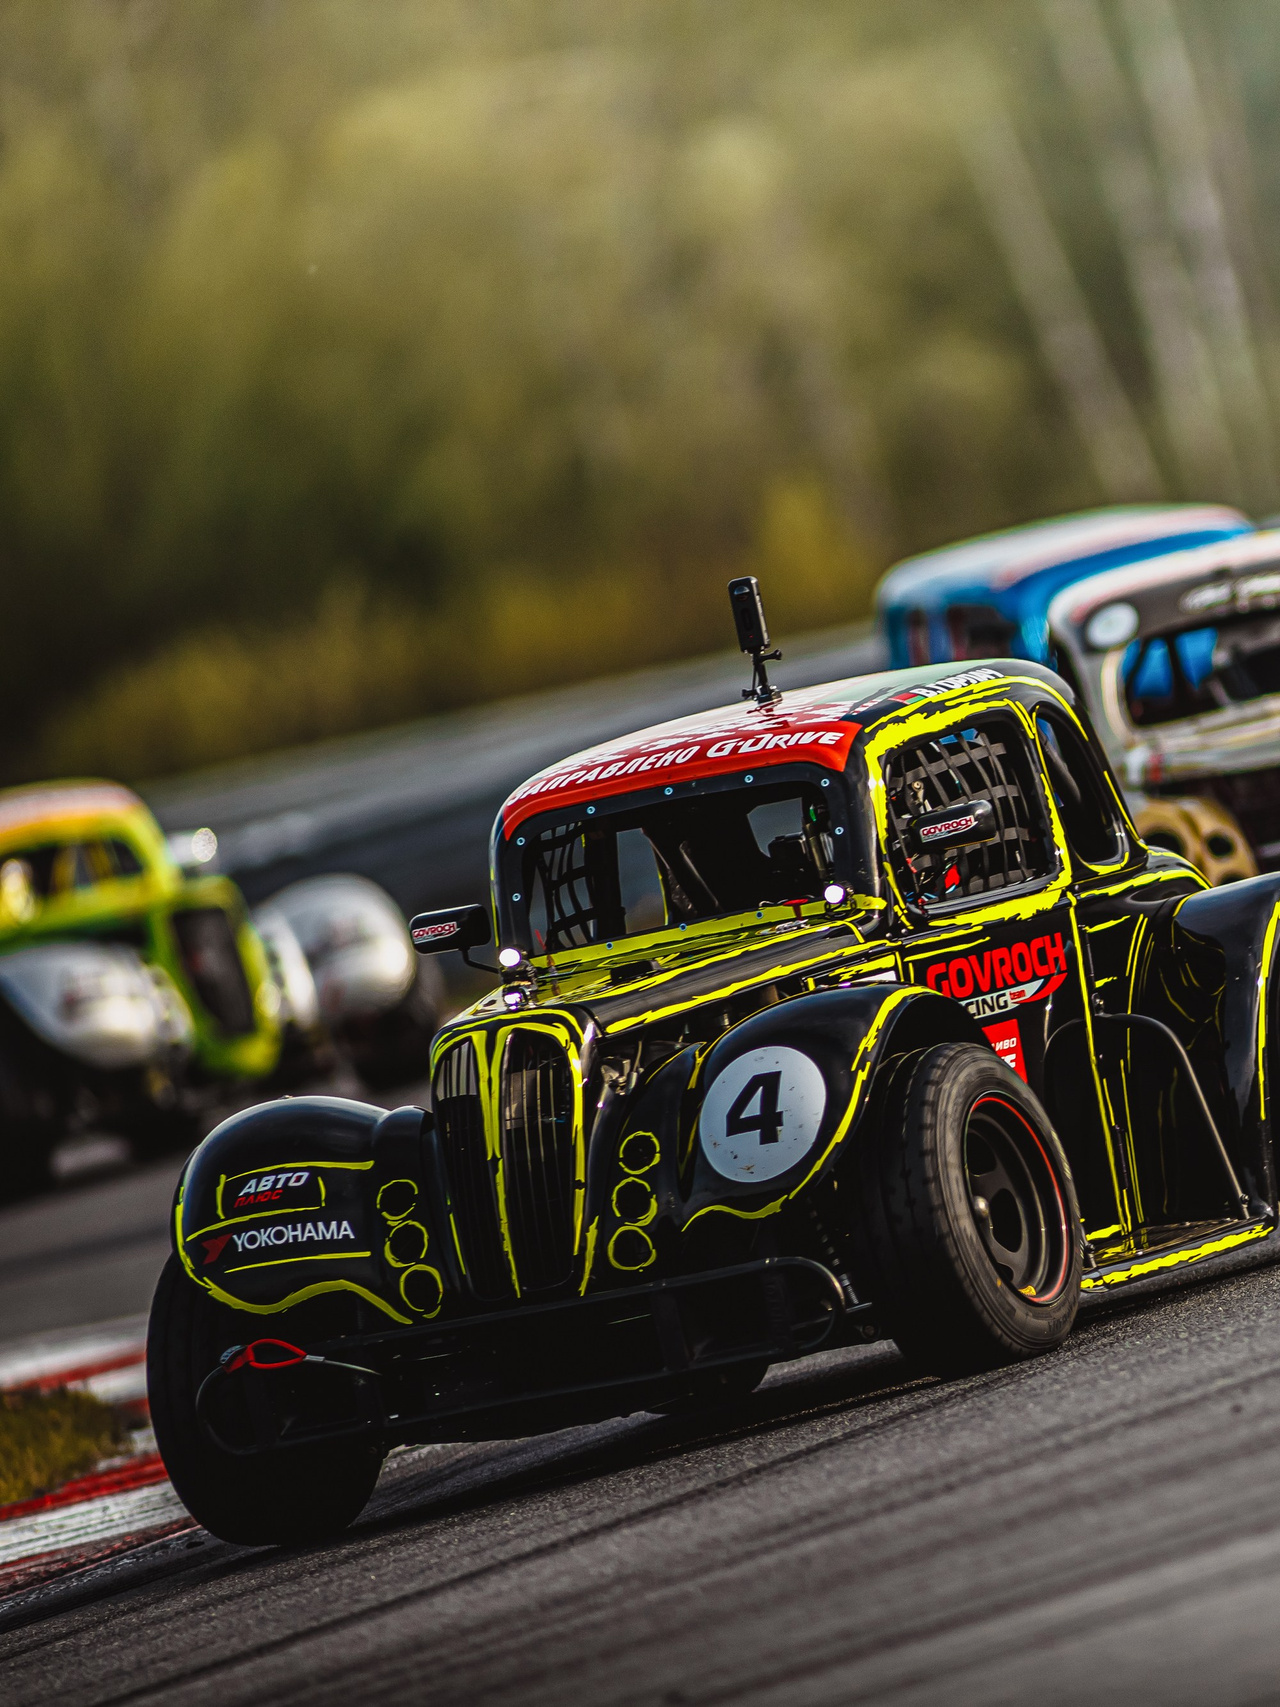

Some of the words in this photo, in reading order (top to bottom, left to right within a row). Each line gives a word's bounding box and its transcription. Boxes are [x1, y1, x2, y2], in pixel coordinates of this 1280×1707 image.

[507, 745, 701, 806] ЗАПРАВЛЕНО
[921, 817, 973, 836] GOVROCH
[413, 923, 456, 938] GOVROCH
[926, 932, 1068, 998] GOVROCH
[965, 992, 1009, 1017] CING
[726, 1070, 784, 1146] 4
[238, 1172, 310, 1197] АВТО
[233, 1189, 283, 1208] ПЛЮС
[232, 1220, 355, 1252] YOKOHAMA
